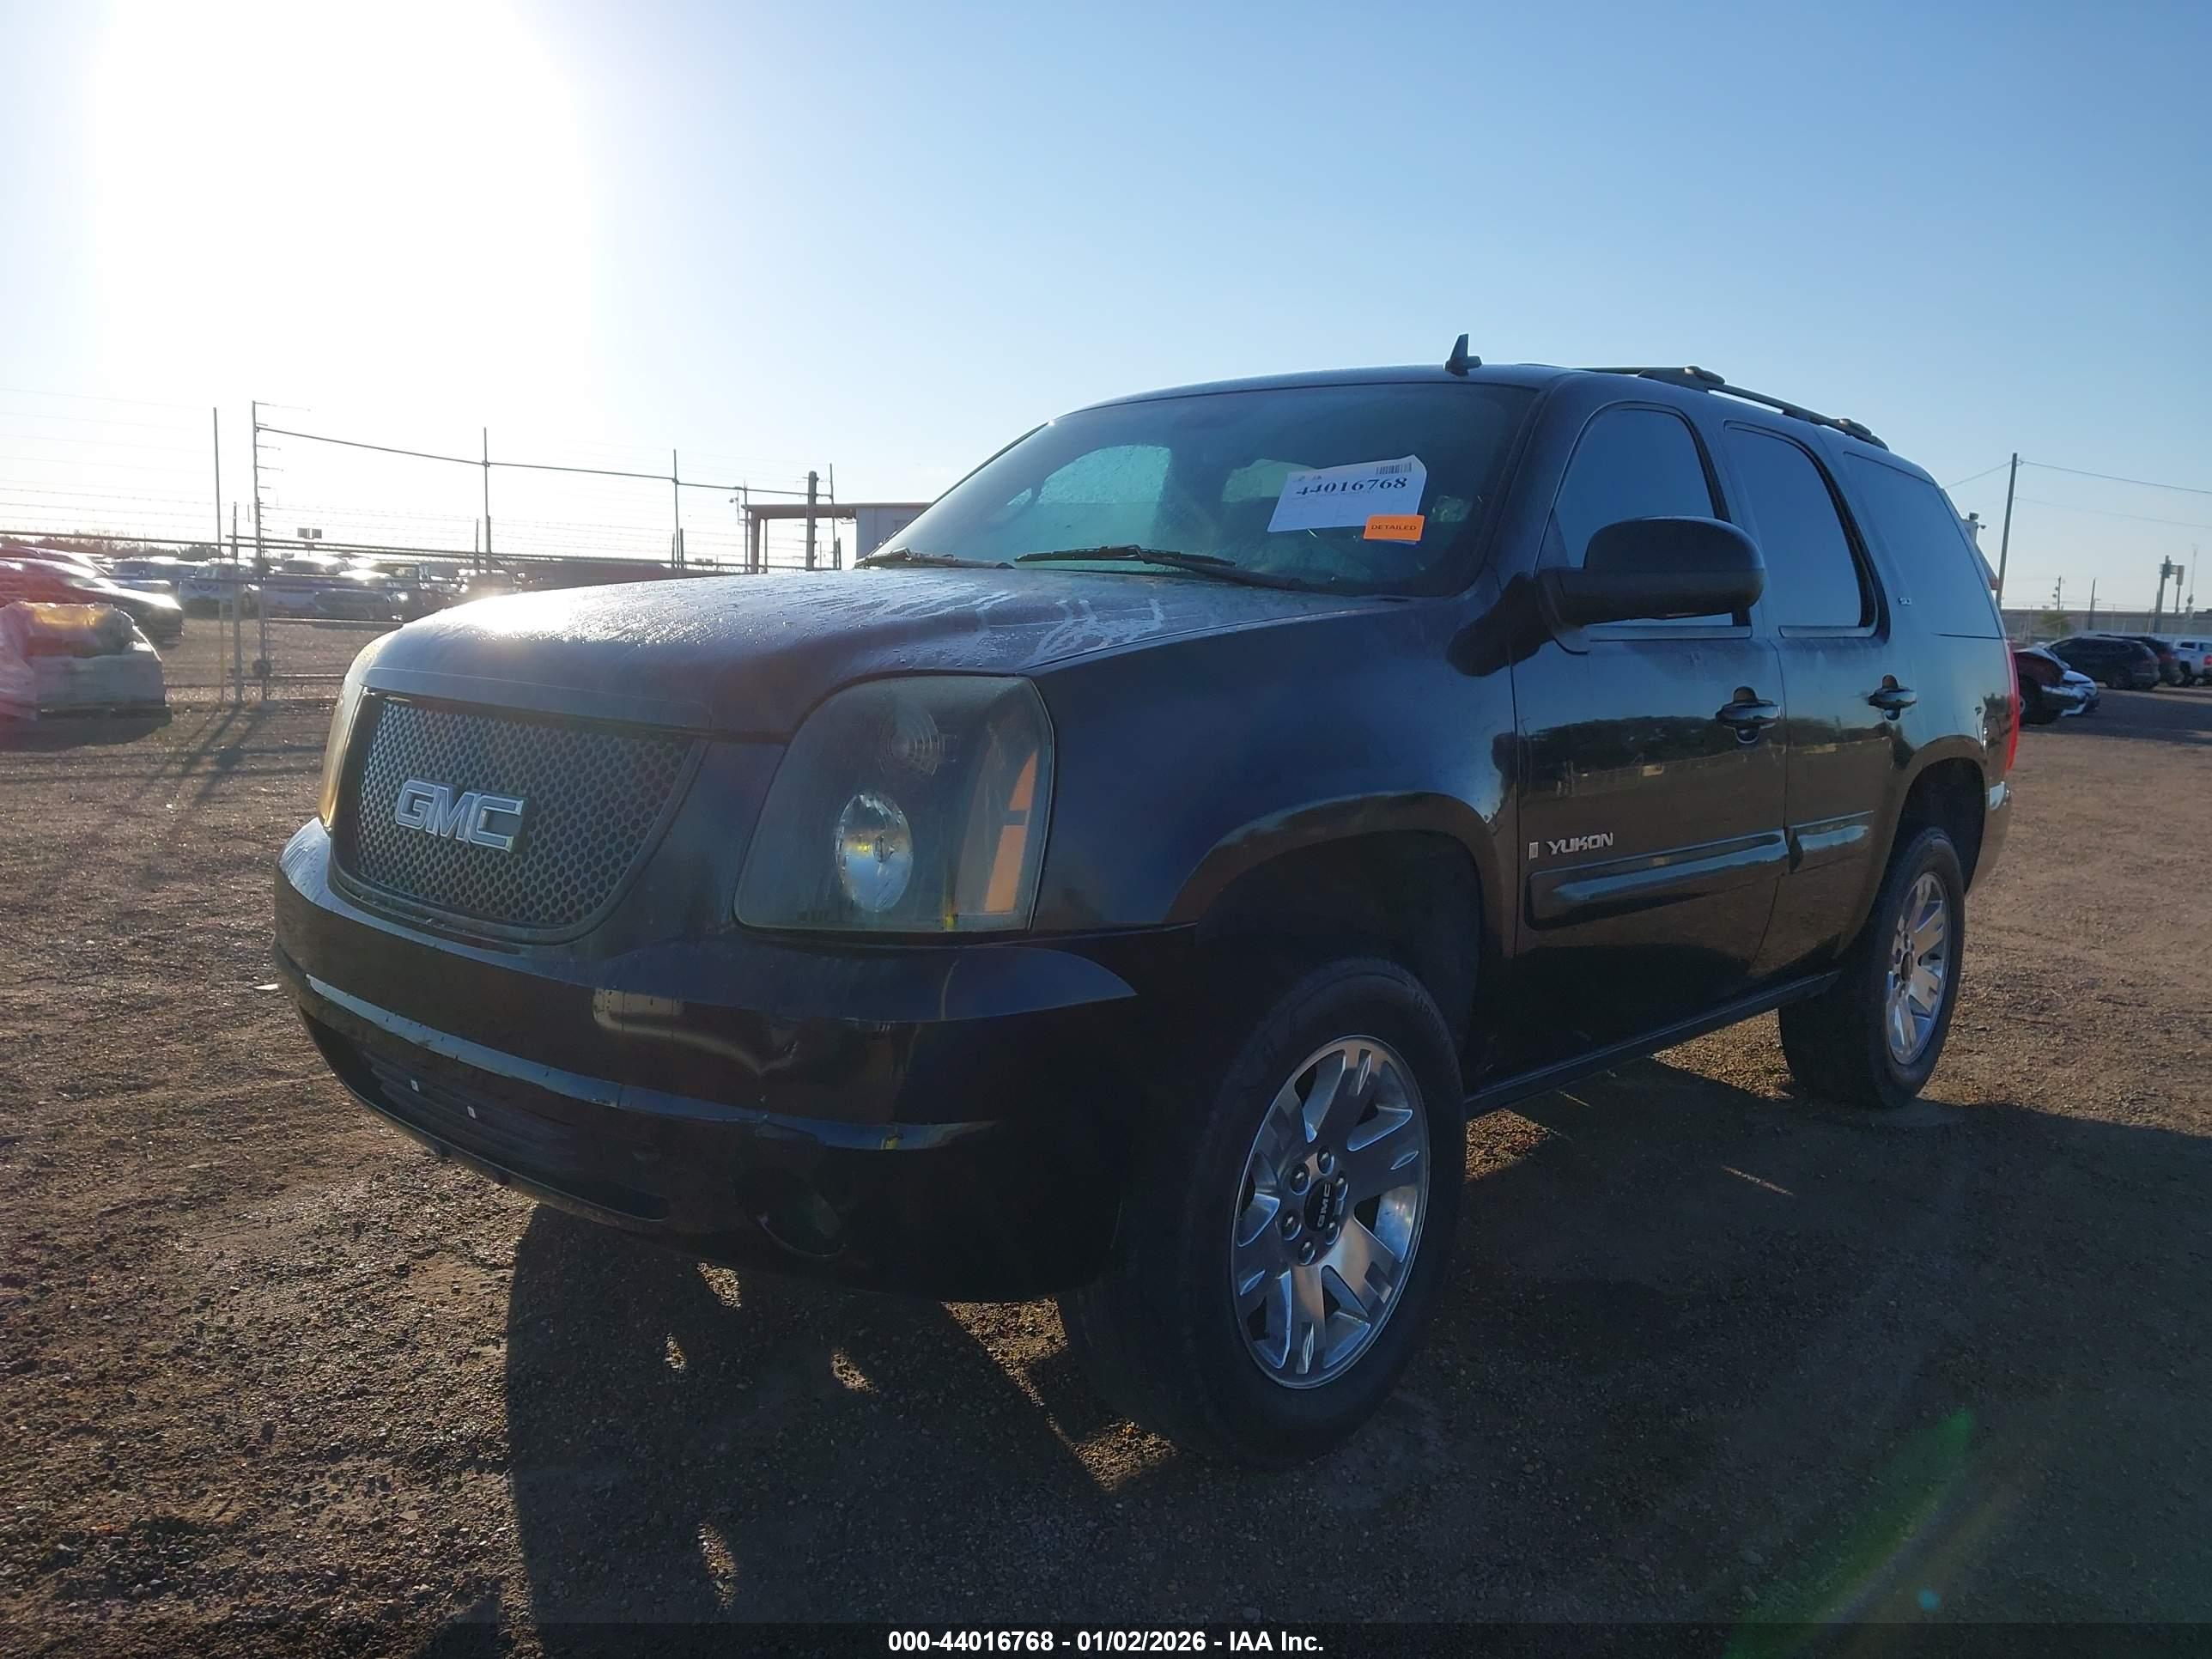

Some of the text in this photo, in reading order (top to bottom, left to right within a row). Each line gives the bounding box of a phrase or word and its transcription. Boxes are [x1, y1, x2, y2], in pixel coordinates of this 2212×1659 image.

[395, 779, 525, 853] GMC
[1547, 832, 1613, 854] YUKON
[1317, 1183, 1331, 1227] GMC
